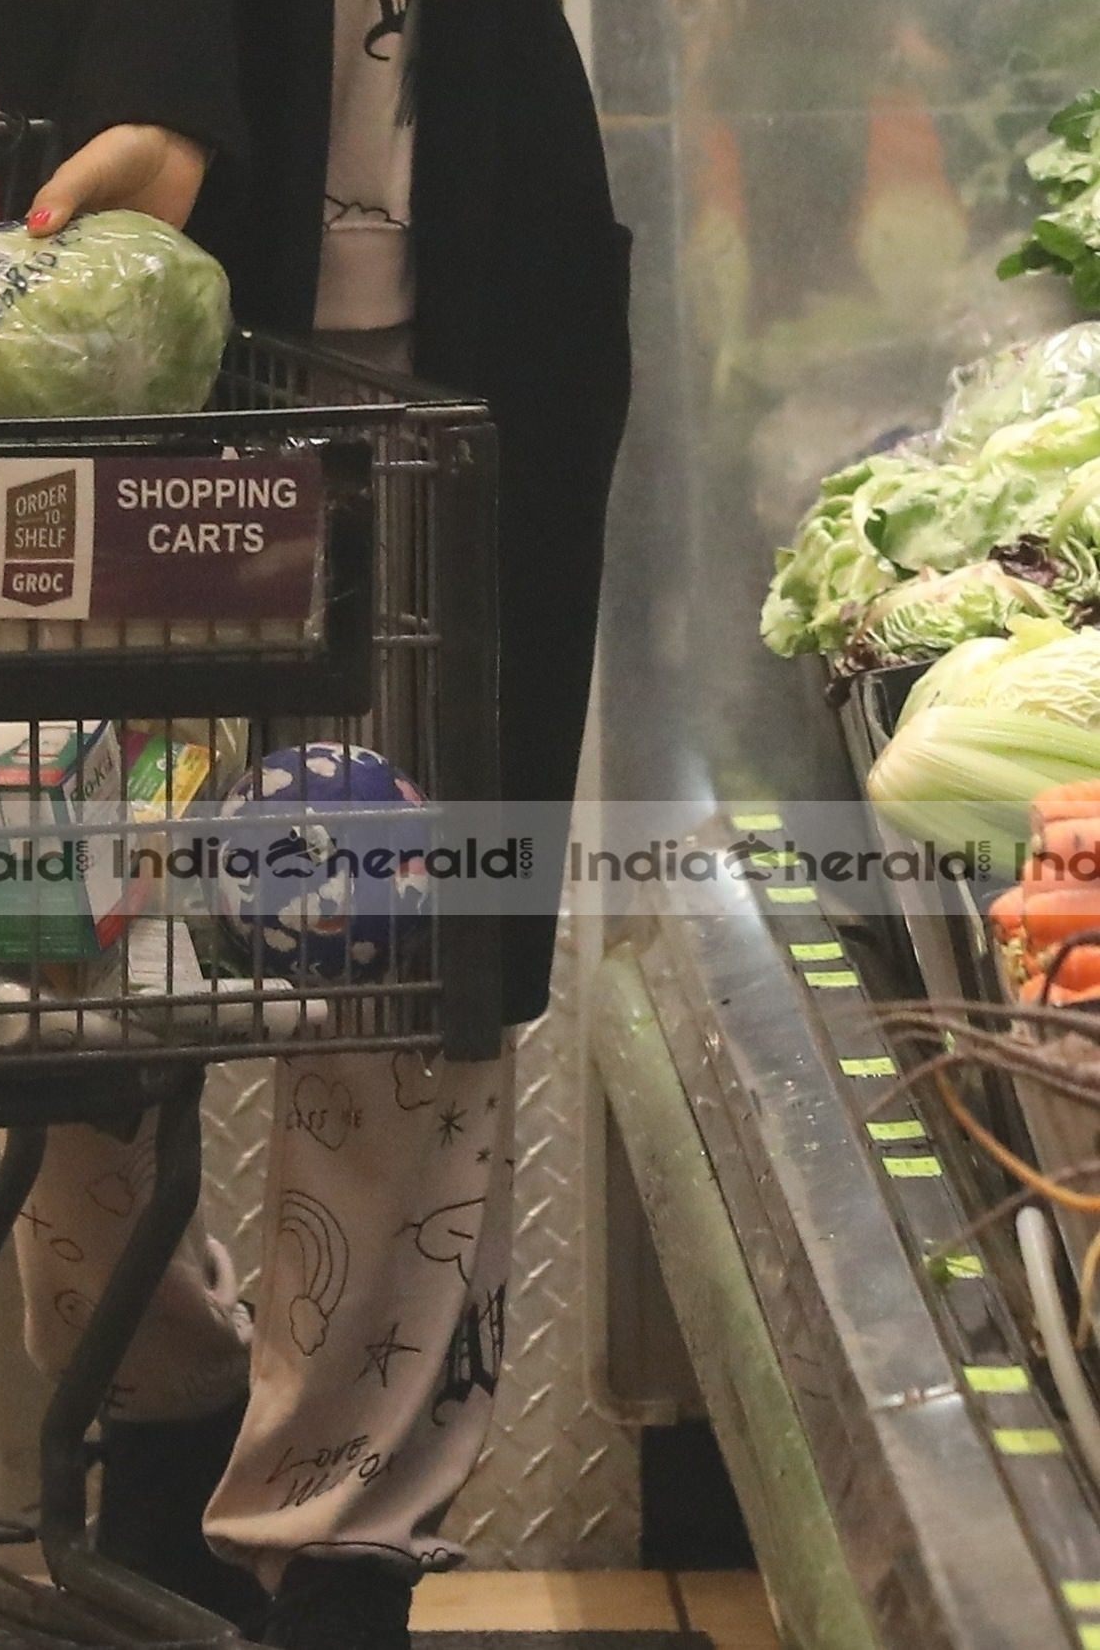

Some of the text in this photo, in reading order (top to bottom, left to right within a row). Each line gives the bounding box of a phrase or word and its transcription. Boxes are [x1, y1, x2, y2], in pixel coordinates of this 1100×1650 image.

[15, 484, 67, 517] ORDER
[116, 477, 298, 510] SHOPPING
[14, 527, 67, 549] SHELF
[147, 523, 265, 554] CARTS
[12, 572, 64, 593] GROC
